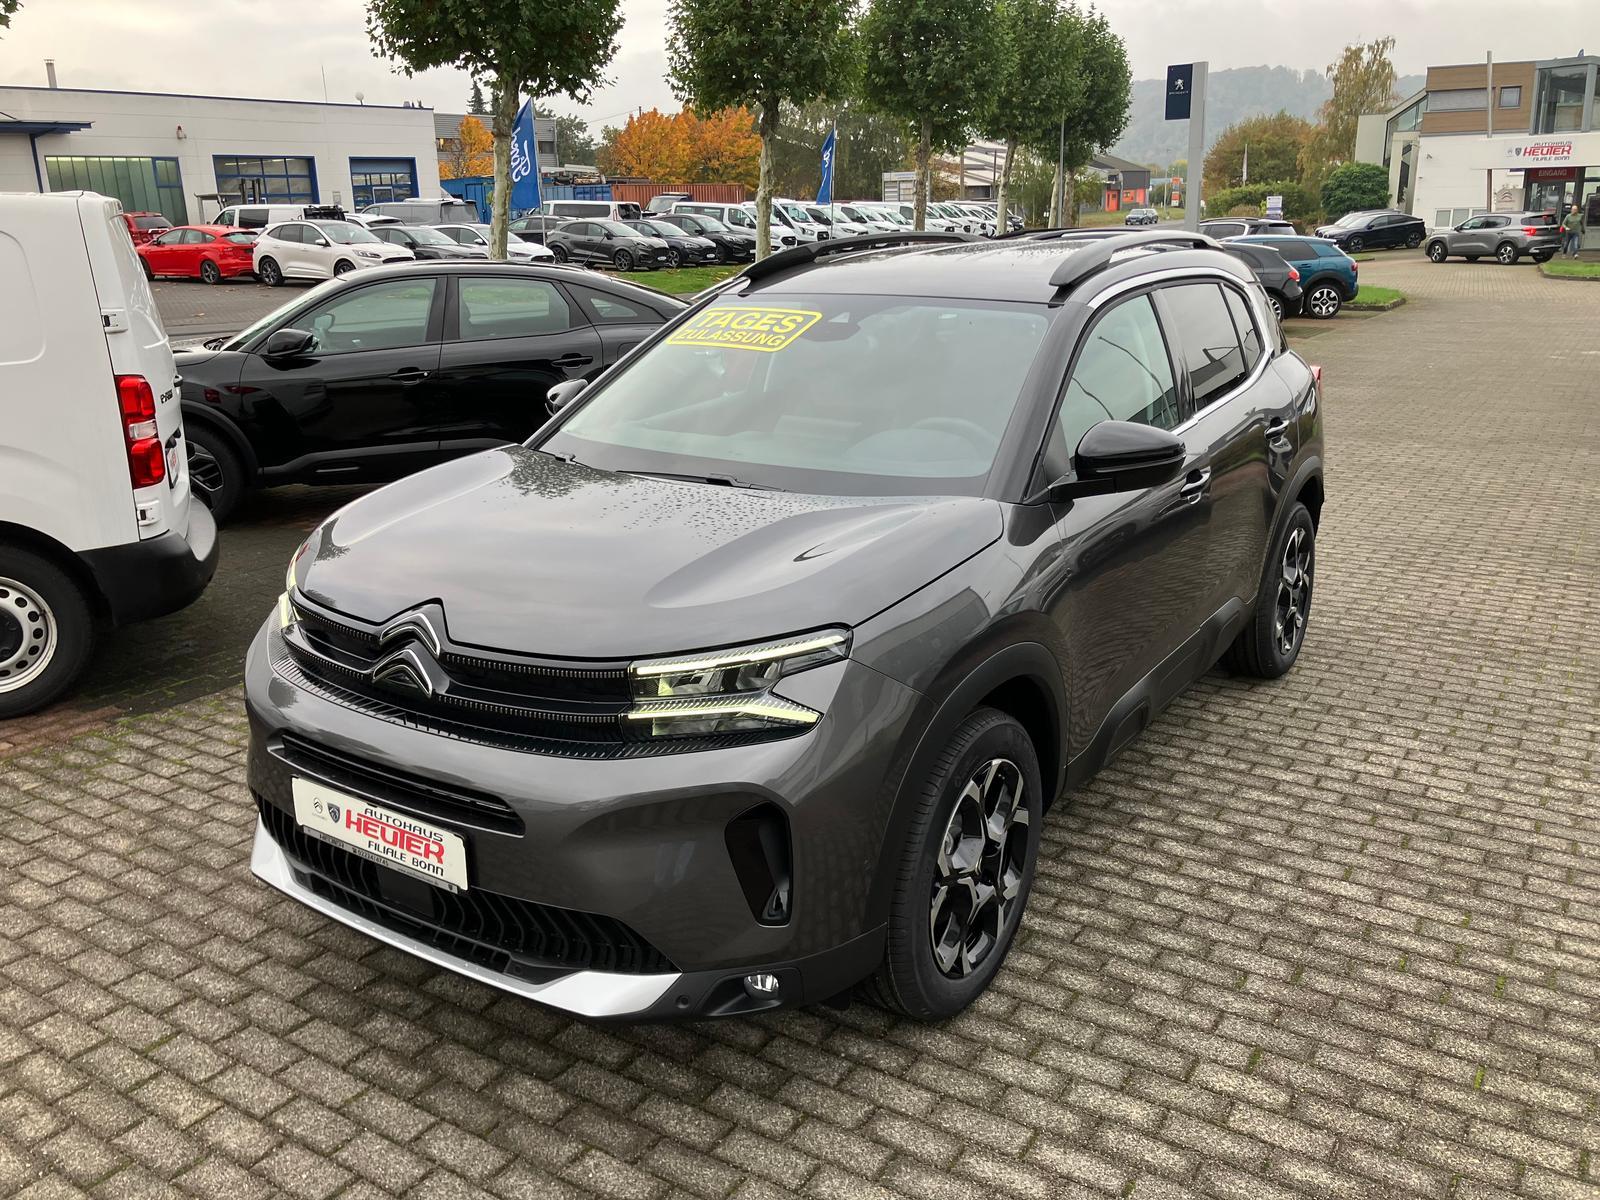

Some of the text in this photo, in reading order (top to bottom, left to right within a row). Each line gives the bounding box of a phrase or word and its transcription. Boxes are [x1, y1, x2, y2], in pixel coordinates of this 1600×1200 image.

[1523, 145, 1572, 157] HEUTER
[1538, 169, 1567, 177] EINGANG
[696, 311, 804, 333] TAGES
[678, 329, 786, 346] ZULASSUNG
[364, 808, 444, 842] AUTOHAUS
[345, 809, 445, 864] HEUTER
[367, 840, 407, 862] FILIALE
[412, 857, 444, 876] BONN
